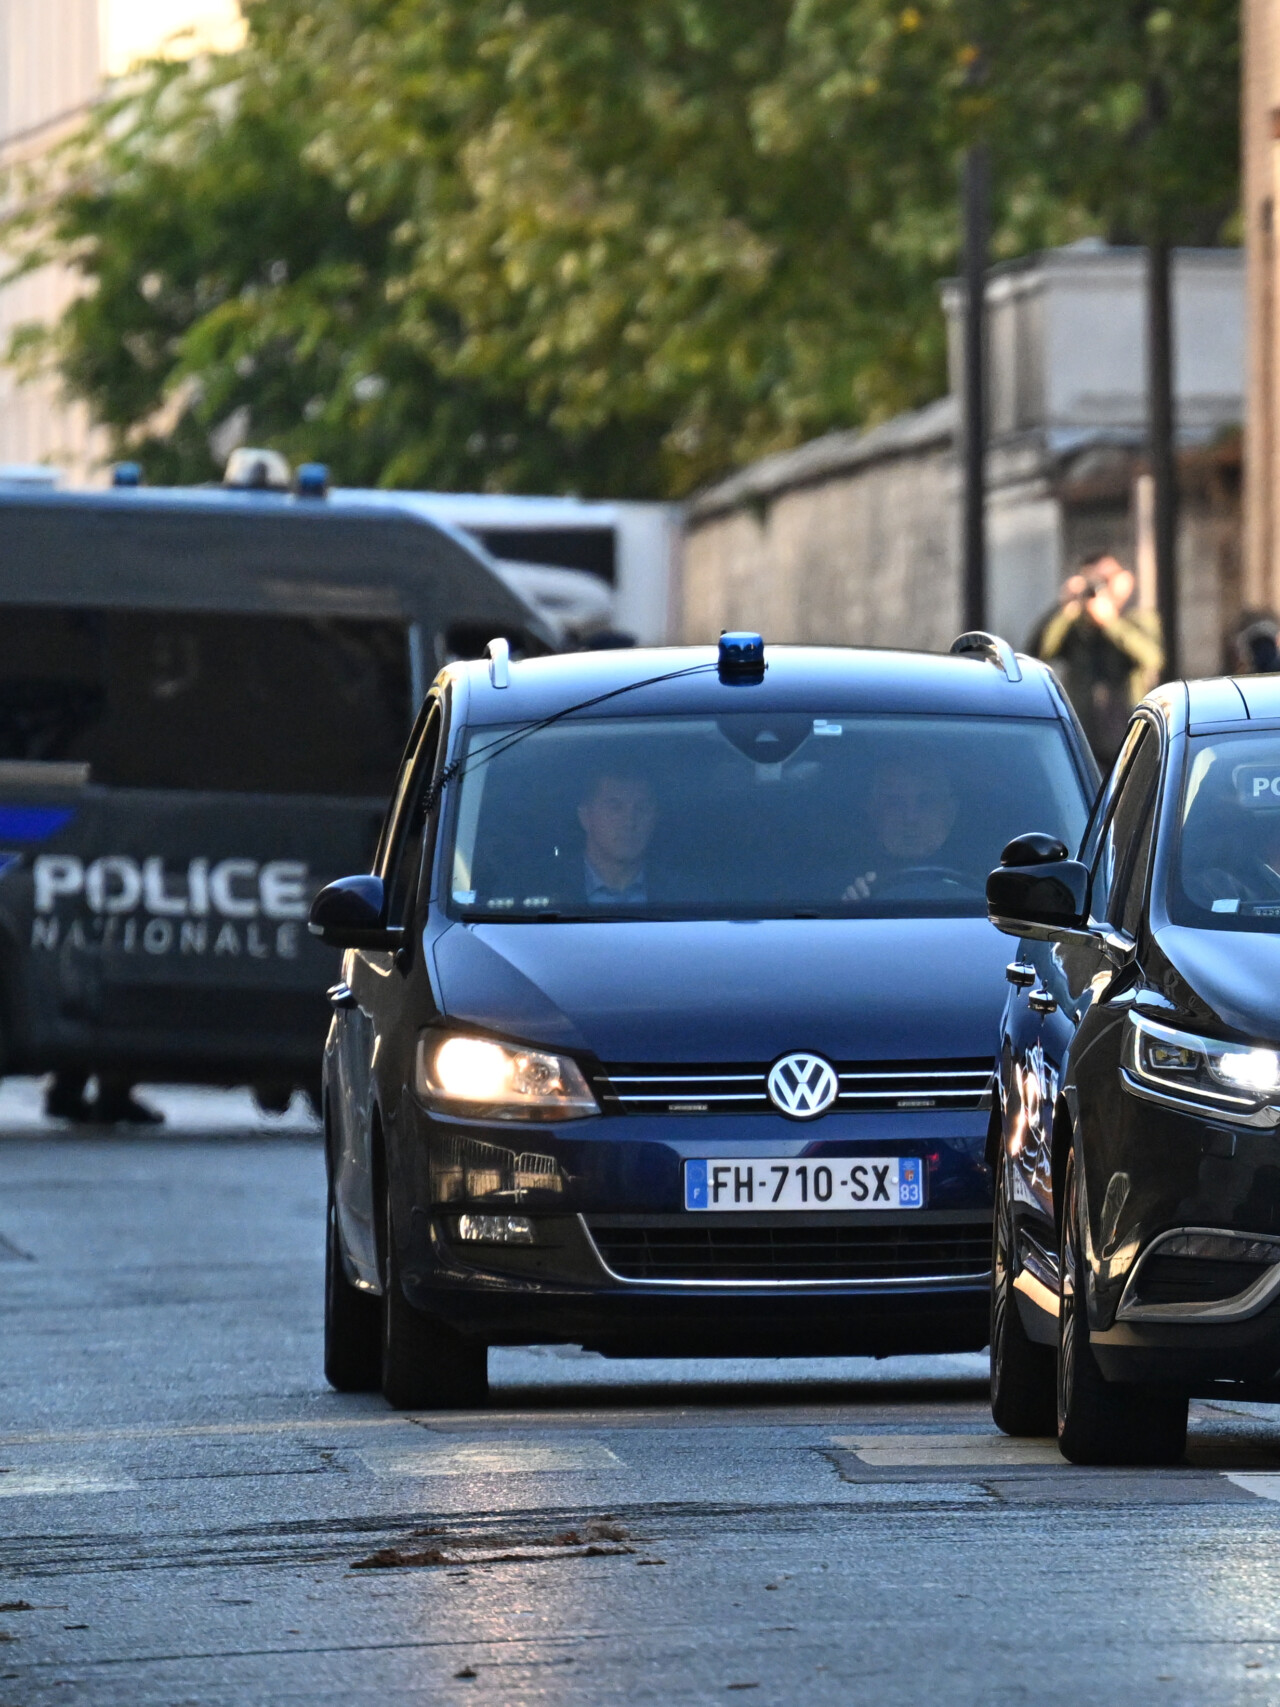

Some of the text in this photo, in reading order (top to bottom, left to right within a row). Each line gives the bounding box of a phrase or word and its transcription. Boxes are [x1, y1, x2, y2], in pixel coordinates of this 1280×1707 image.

[33, 854, 308, 919] POLICE
[693, 1188, 701, 1200] F
[712, 1165, 890, 1203] FH-710-SX
[900, 1184, 919, 1201] 83
